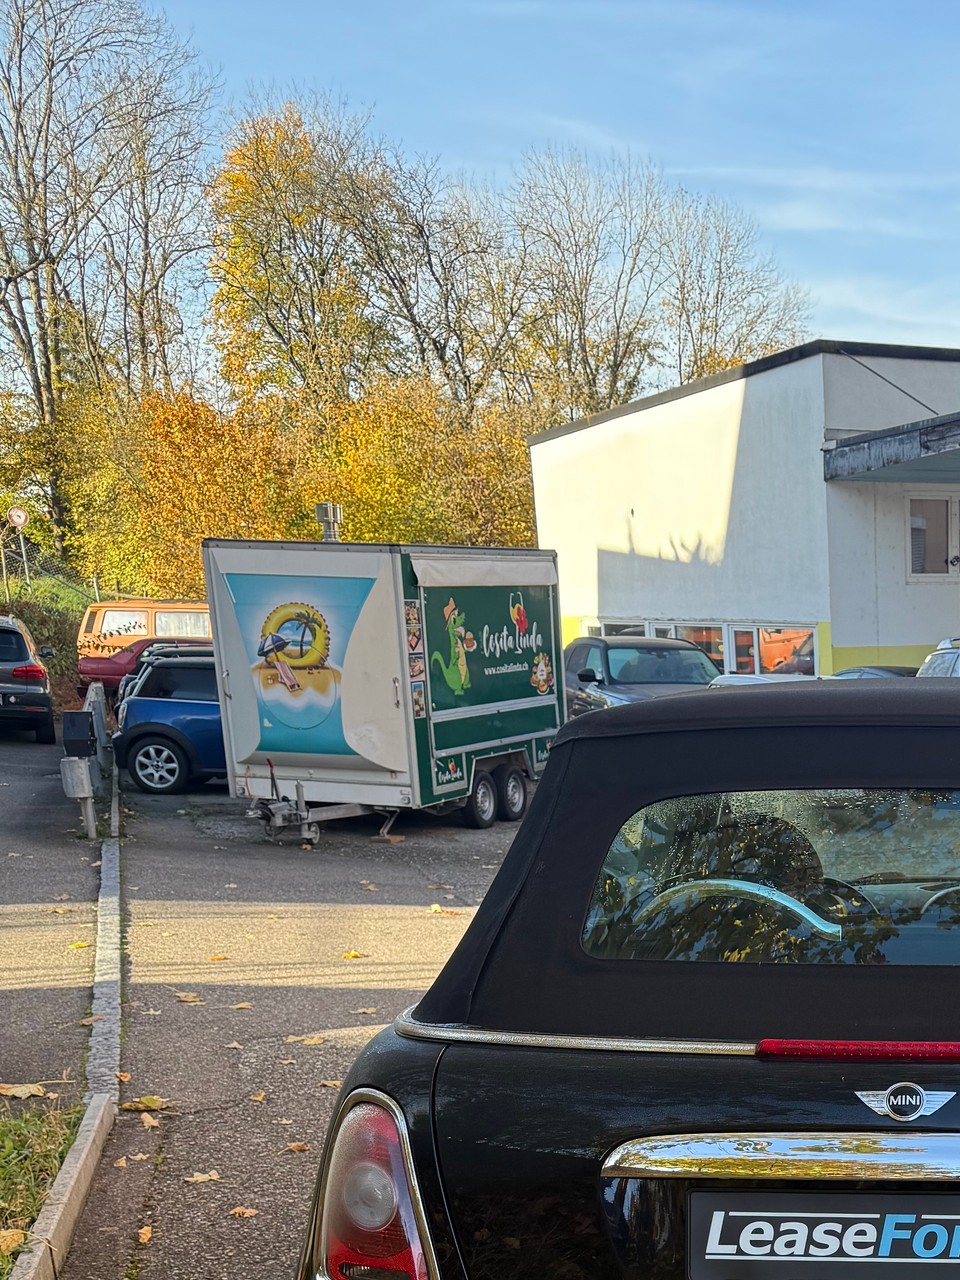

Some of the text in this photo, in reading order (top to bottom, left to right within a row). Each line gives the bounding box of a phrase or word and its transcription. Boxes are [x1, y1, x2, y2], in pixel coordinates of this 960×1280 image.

[483, 621, 543, 658] Cosita Linda
[484, 661, 529, 676] www.cositalinda.ch
[889, 1095, 920, 1106] MINI
